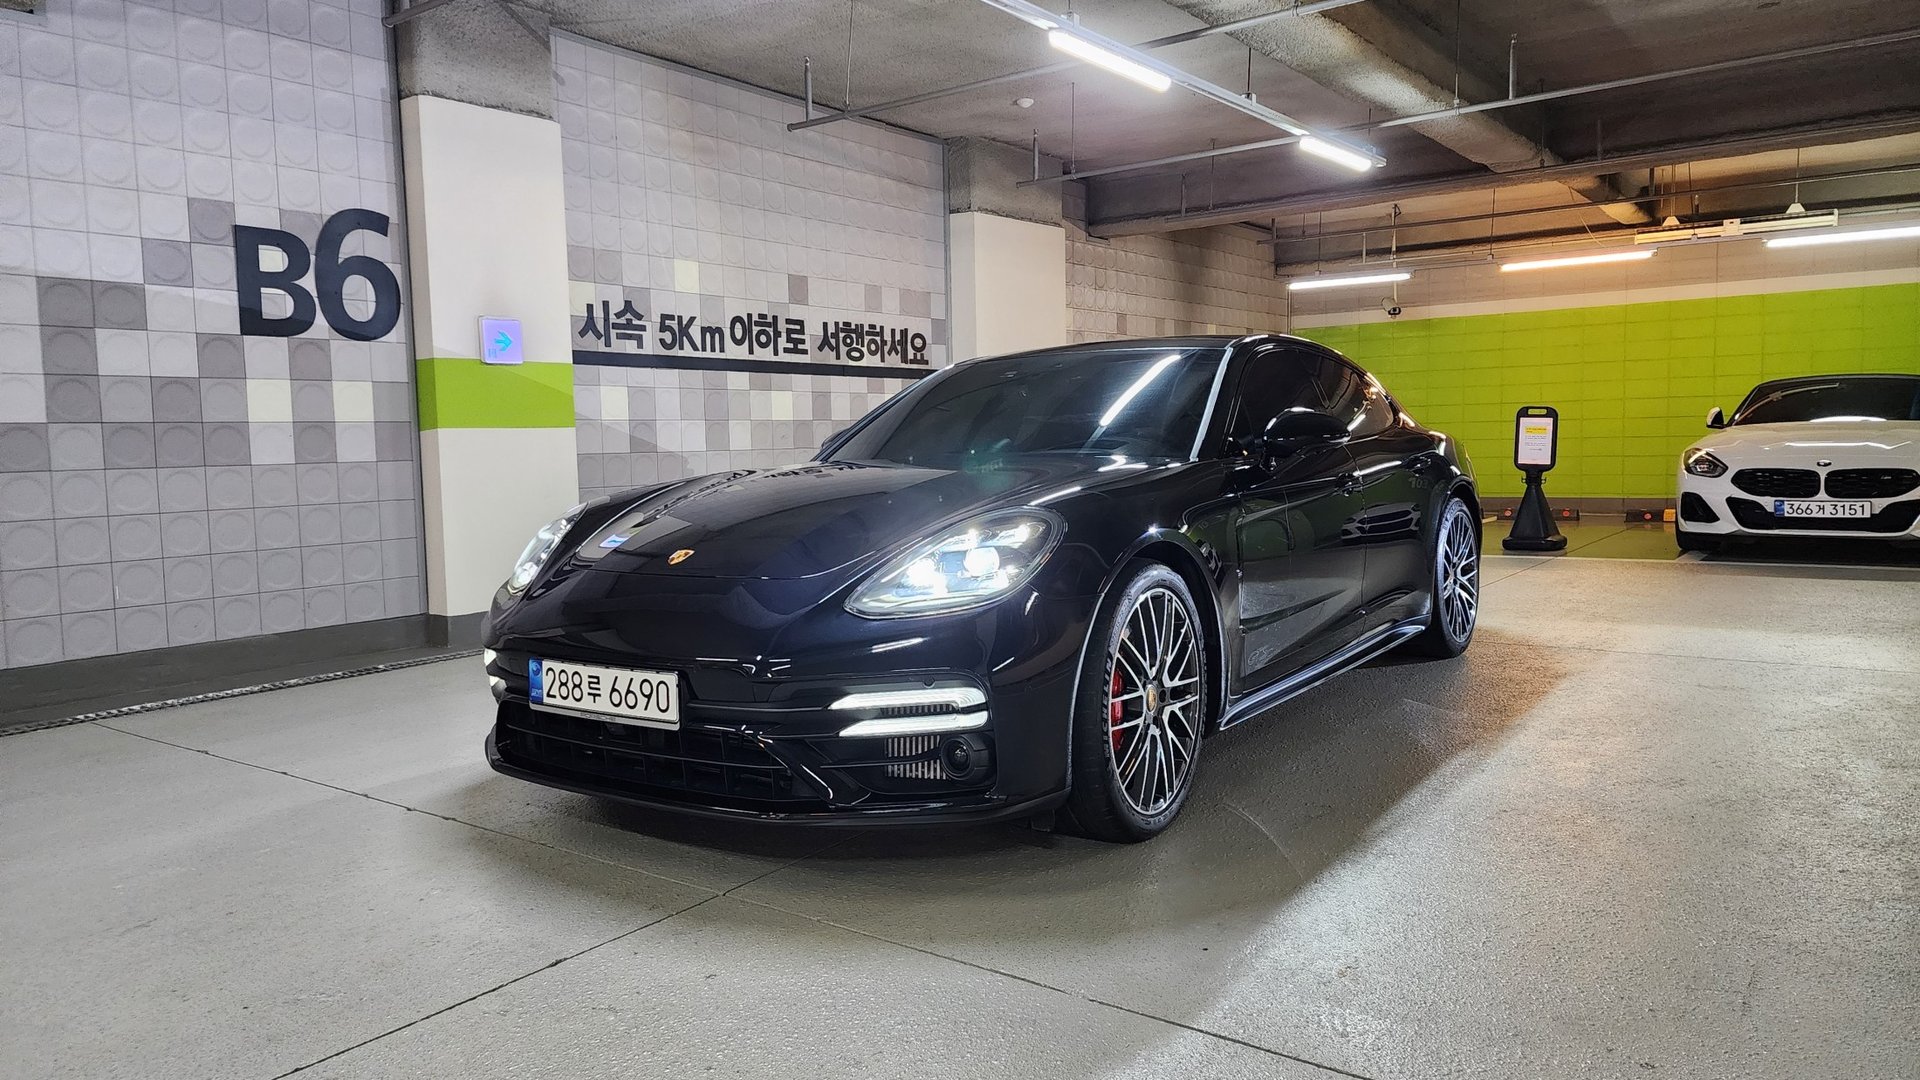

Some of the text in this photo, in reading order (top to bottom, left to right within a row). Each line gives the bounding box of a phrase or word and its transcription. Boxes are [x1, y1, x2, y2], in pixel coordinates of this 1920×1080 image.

[233, 208, 401, 341] B6
[577, 301, 929, 366] 시속 5Km 이하로 서행하세요
[1786, 503, 1865, 516] 366거 3151
[545, 667, 670, 713] 288루 6690
[1103, 657, 1112, 757] MICHELIN
